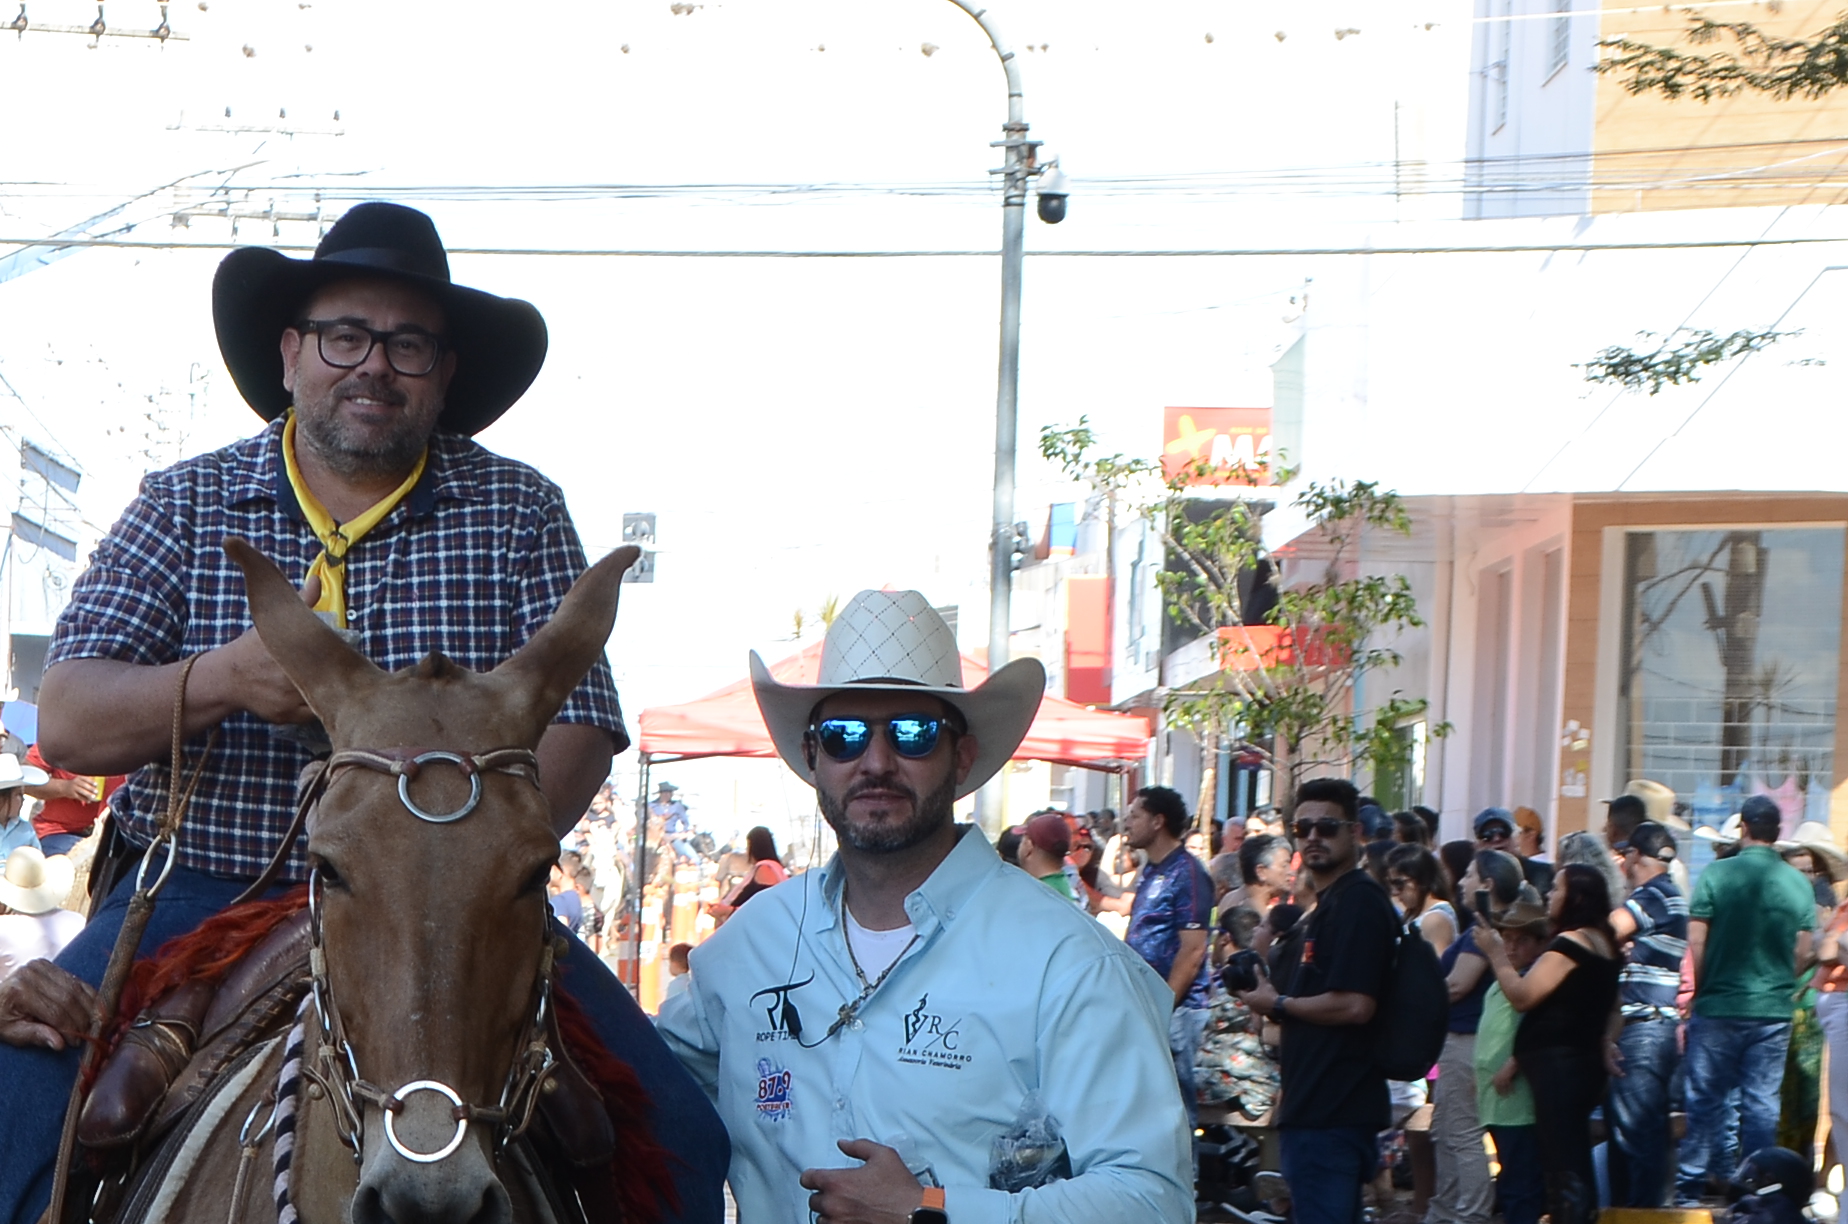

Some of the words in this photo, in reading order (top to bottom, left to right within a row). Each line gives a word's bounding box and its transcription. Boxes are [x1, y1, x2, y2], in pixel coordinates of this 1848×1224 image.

[756, 1030, 775, 1042] ROPE
[921, 1049, 973, 1063] CHAMORRO
[758, 1071, 791, 1099] 87.9
